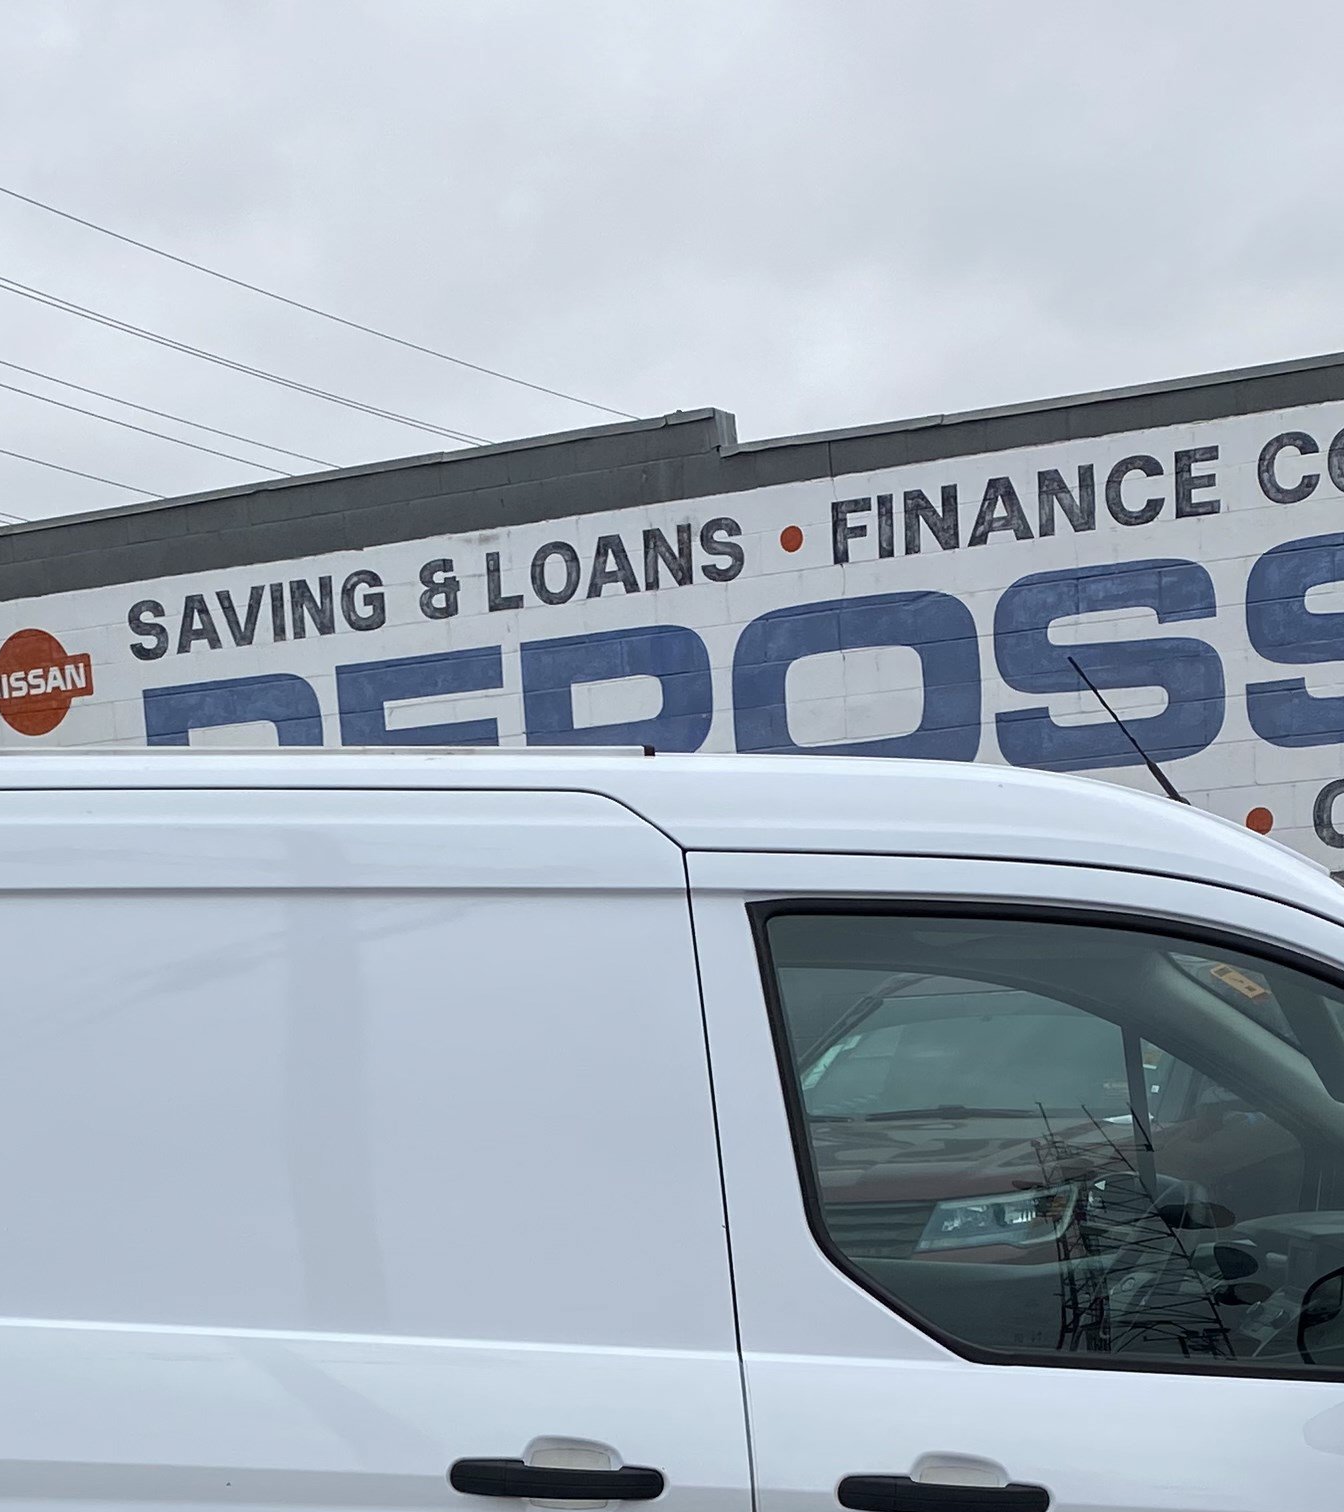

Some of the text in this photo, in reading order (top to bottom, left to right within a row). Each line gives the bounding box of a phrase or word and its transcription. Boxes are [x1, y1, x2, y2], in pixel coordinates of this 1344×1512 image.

[127, 568, 387, 662] SAVING
[419, 558, 460, 621] &
[487, 517, 744, 614] LOANS
[831, 444, 1222, 566] FINANCE
